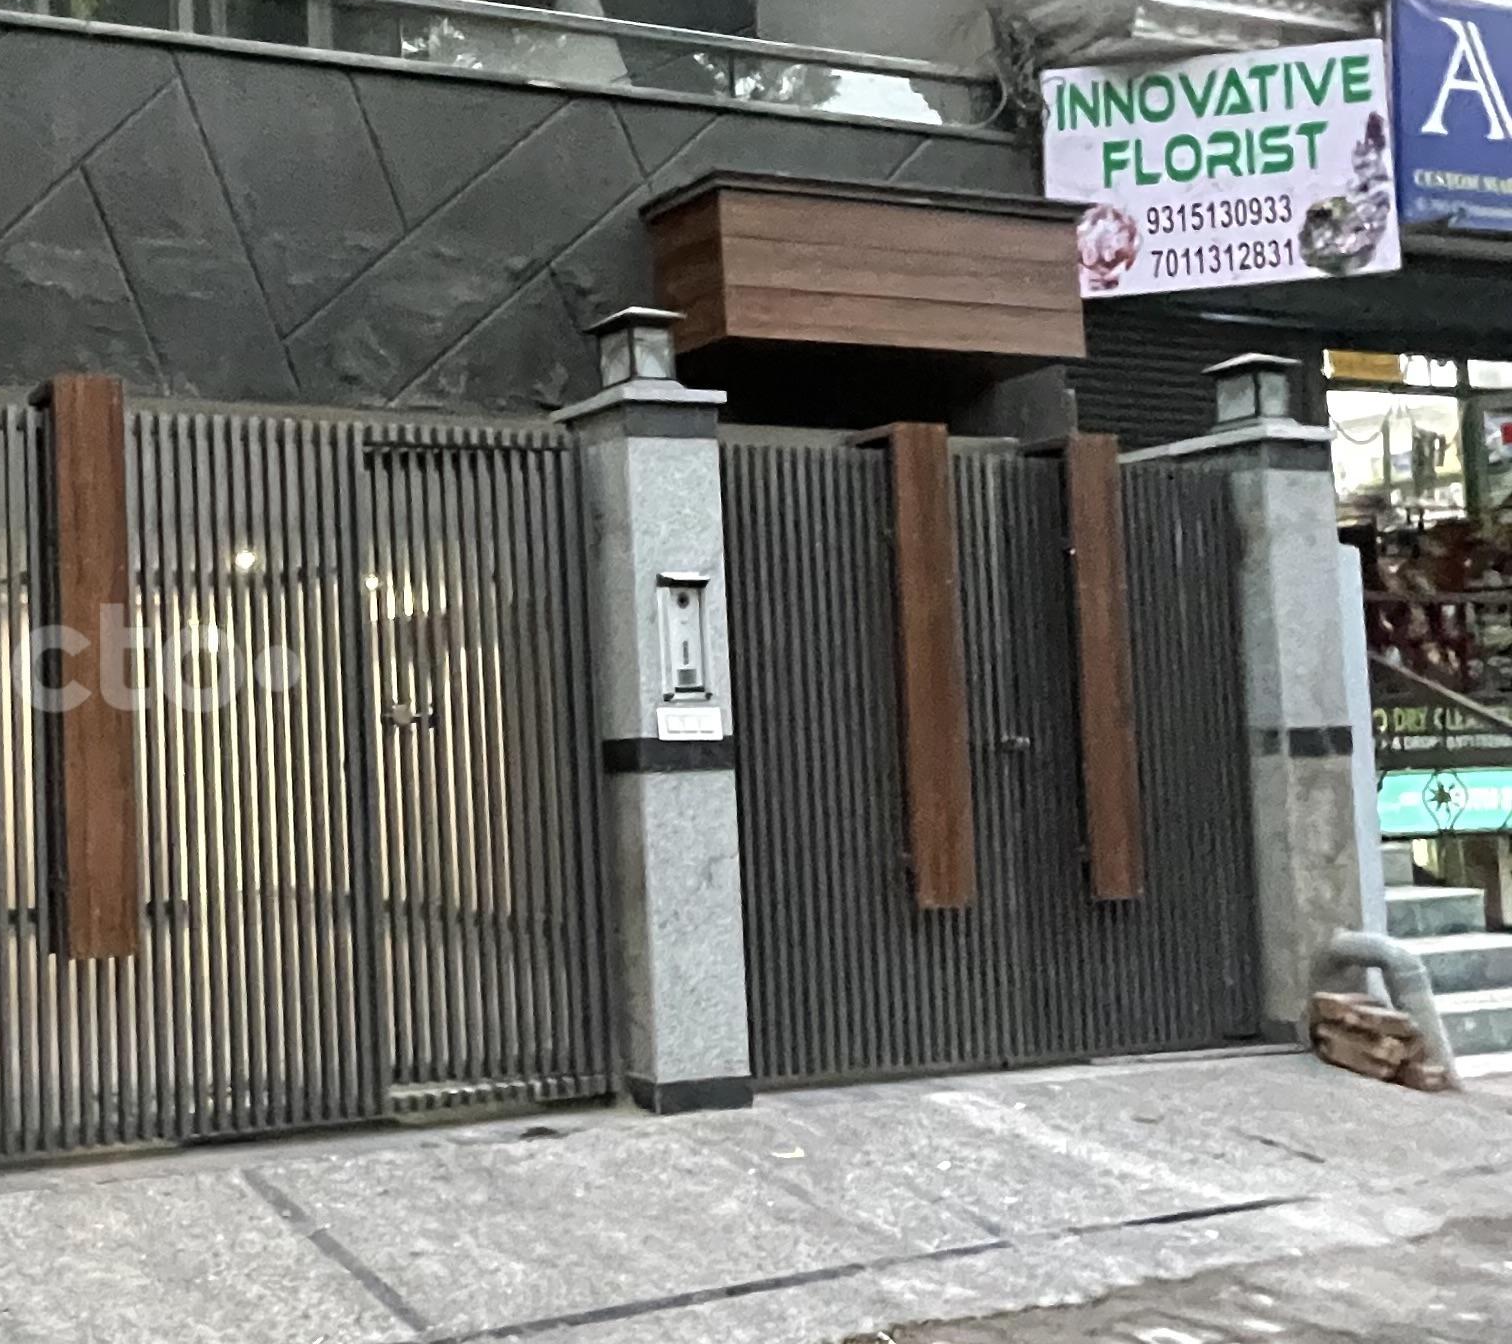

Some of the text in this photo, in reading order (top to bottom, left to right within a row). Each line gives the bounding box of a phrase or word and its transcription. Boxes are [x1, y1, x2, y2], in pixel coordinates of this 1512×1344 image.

[1056, 54, 1373, 132] INNOVATIVE
[1102, 120, 1329, 189] FLORIST
[1146, 194, 1293, 235] 9315130933
[1150, 238, 1295, 278] 7011312831
